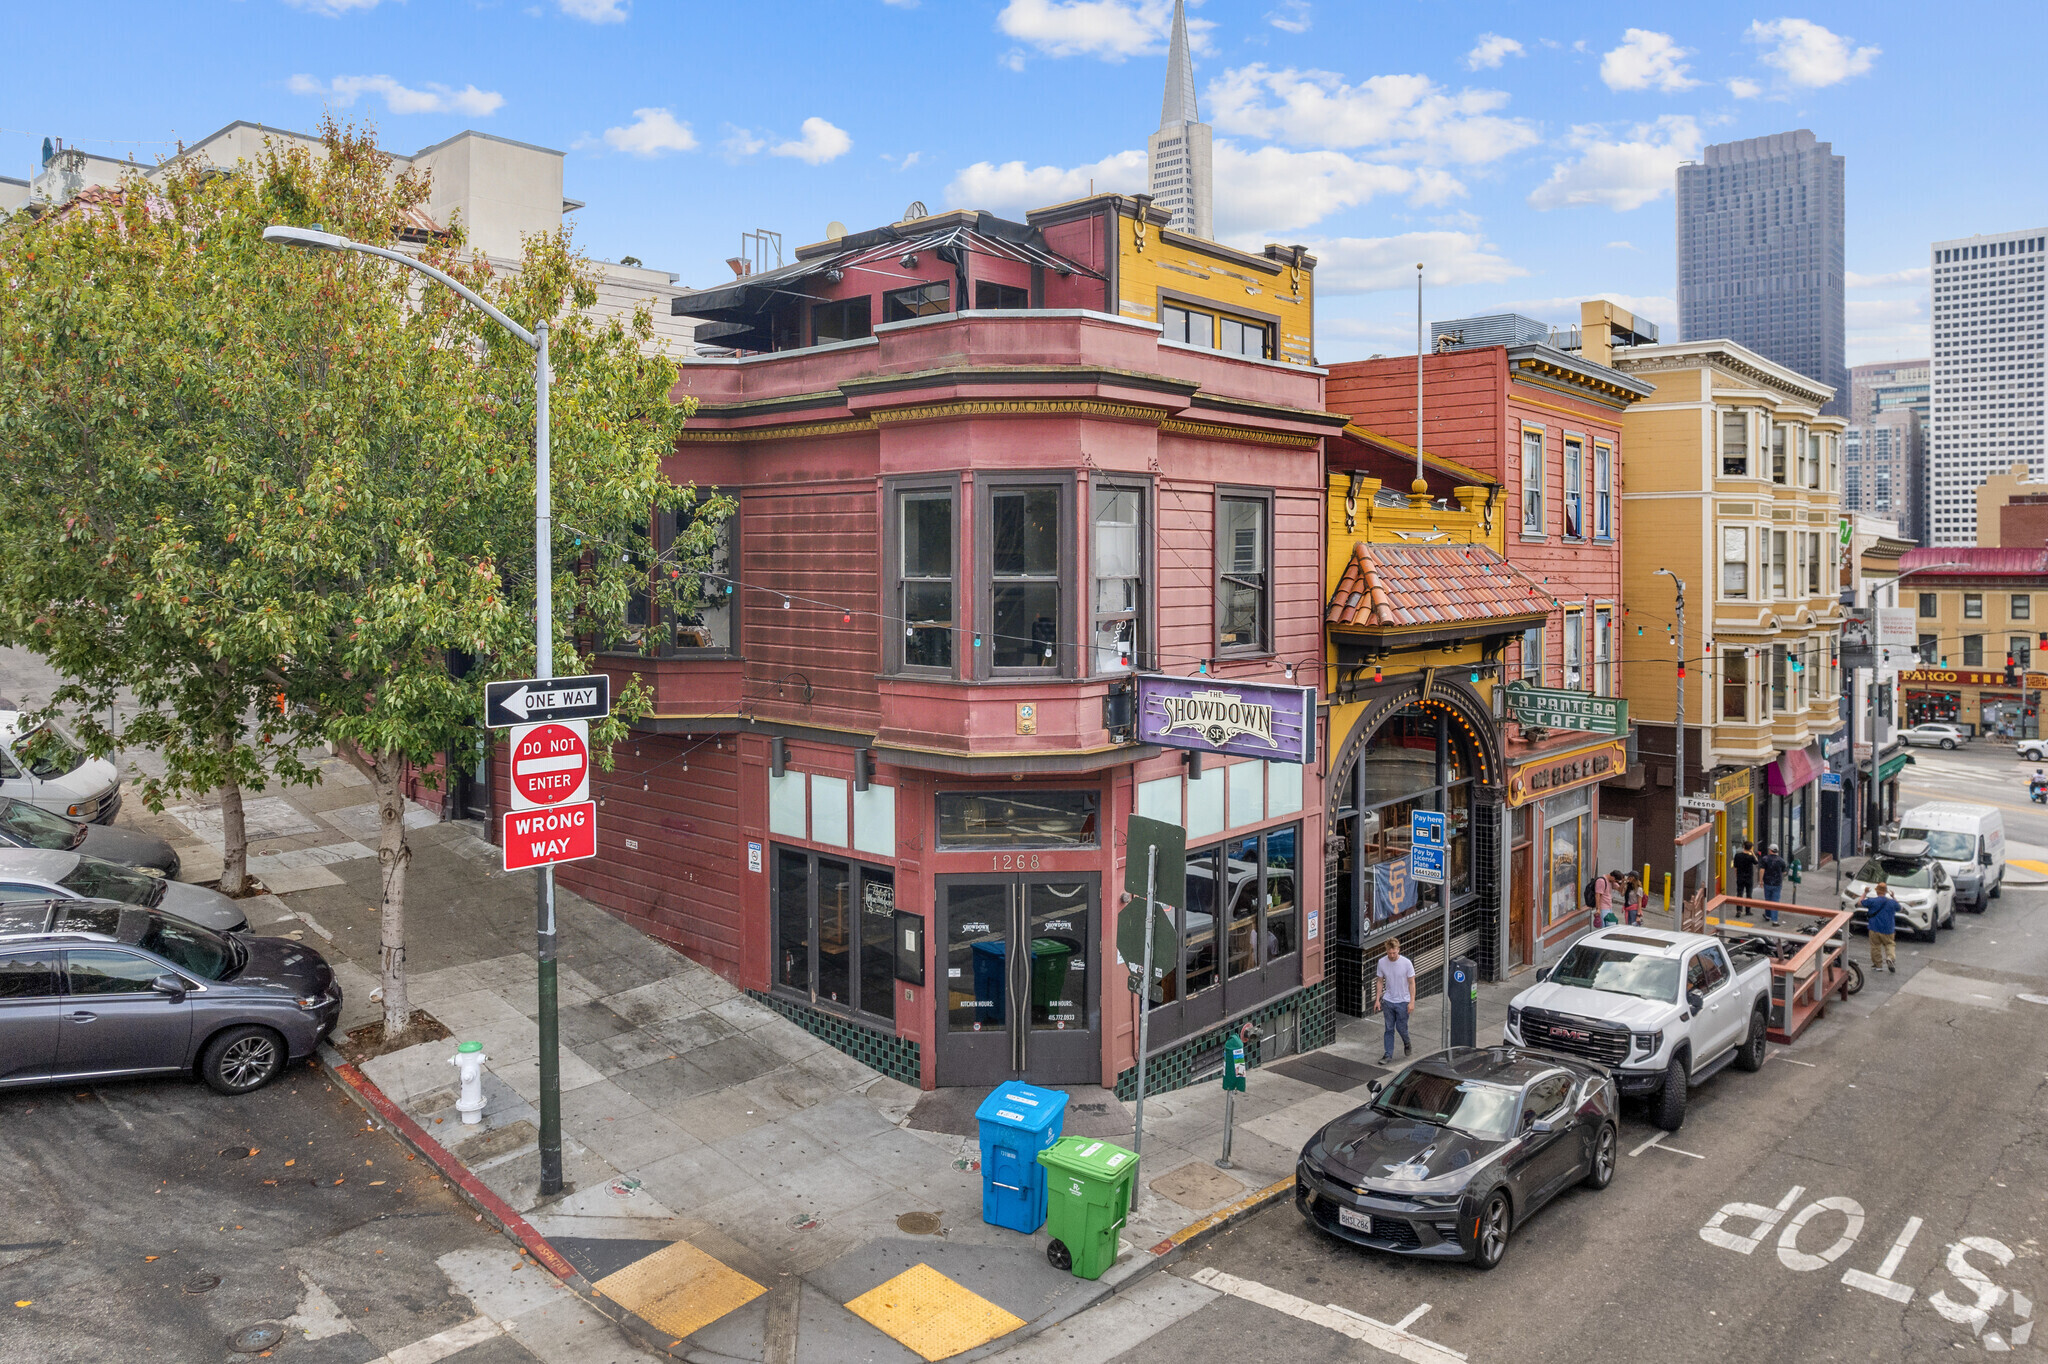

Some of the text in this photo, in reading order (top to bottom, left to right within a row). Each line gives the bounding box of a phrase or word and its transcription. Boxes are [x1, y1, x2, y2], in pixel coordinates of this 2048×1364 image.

[1902, 670, 1957, 682] FARGO
[526, 689, 593, 709] ONE WAY
[1209, 691, 1223, 699] THE
[1507, 694, 1616, 717] LA PANTERA
[1160, 698, 1273, 737] SHOWDOWN
[1536, 712, 1591, 729] CAFE
[1209, 728, 1222, 739] SF
[523, 738, 576, 756] DO NOT
[528, 774, 571, 791] ENTER
[1688, 799, 1715, 808] Fresno
[516, 811, 585, 836] WRONG
[1414, 814, 1427, 823] Pay
[1427, 815, 1443, 824] here
[531, 837, 571, 858] WAY
[1414, 848, 1434, 858] Pay by
[993, 855, 1040, 871] 1268
[1414, 854, 1436, 863] License
[1414, 860, 1429, 869] Plate
[962, 924, 990, 934] SHOWDOWN
[1044, 922, 1072, 931] SHOWDOWN
[1550, 1027, 1590, 1042] GMC
[540, 1248, 565, 1270] SFMTA
[1699, 1185, 2016, 1324] STOP
